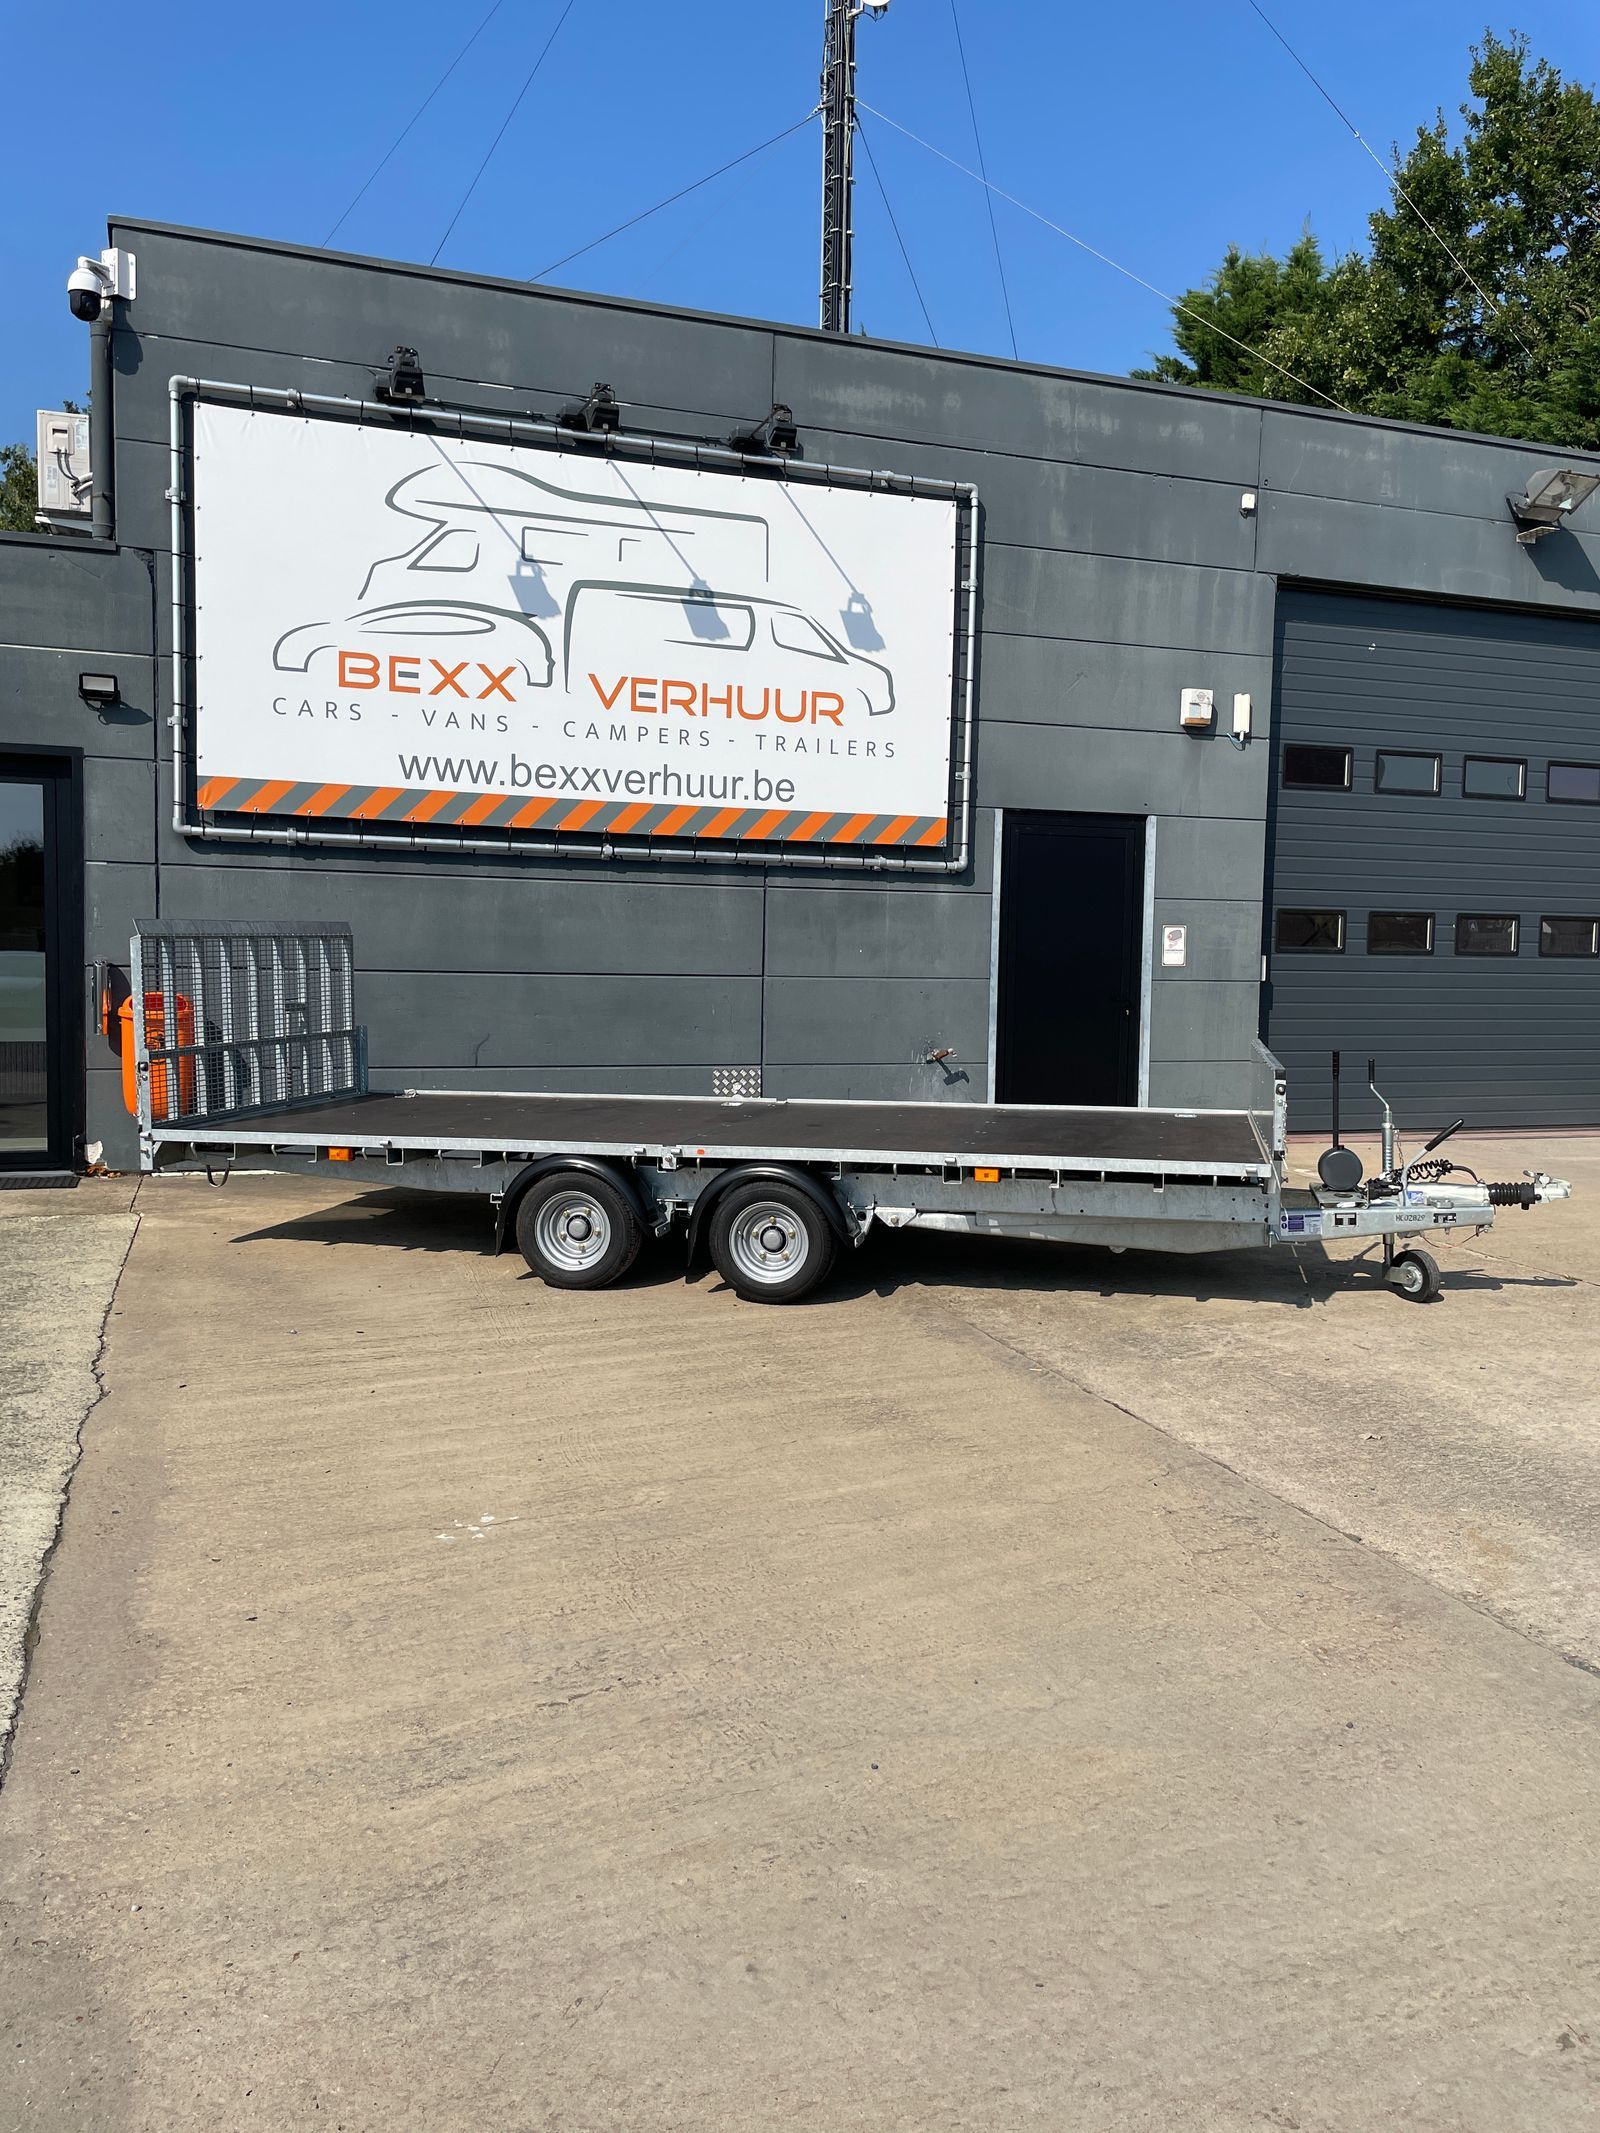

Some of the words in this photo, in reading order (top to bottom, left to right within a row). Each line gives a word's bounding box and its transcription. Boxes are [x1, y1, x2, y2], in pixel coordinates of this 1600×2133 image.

[339, 651, 515, 702] BEXX
[589, 674, 845, 727] VERHUUR
[273, 698, 362, 721] CARS
[422, 708, 508, 733] VANS
[564, 720, 710, 747] CAMPERS
[756, 735, 895, 758] TRAILERS
[398, 754, 795, 804] www.bexxverhuur.be
